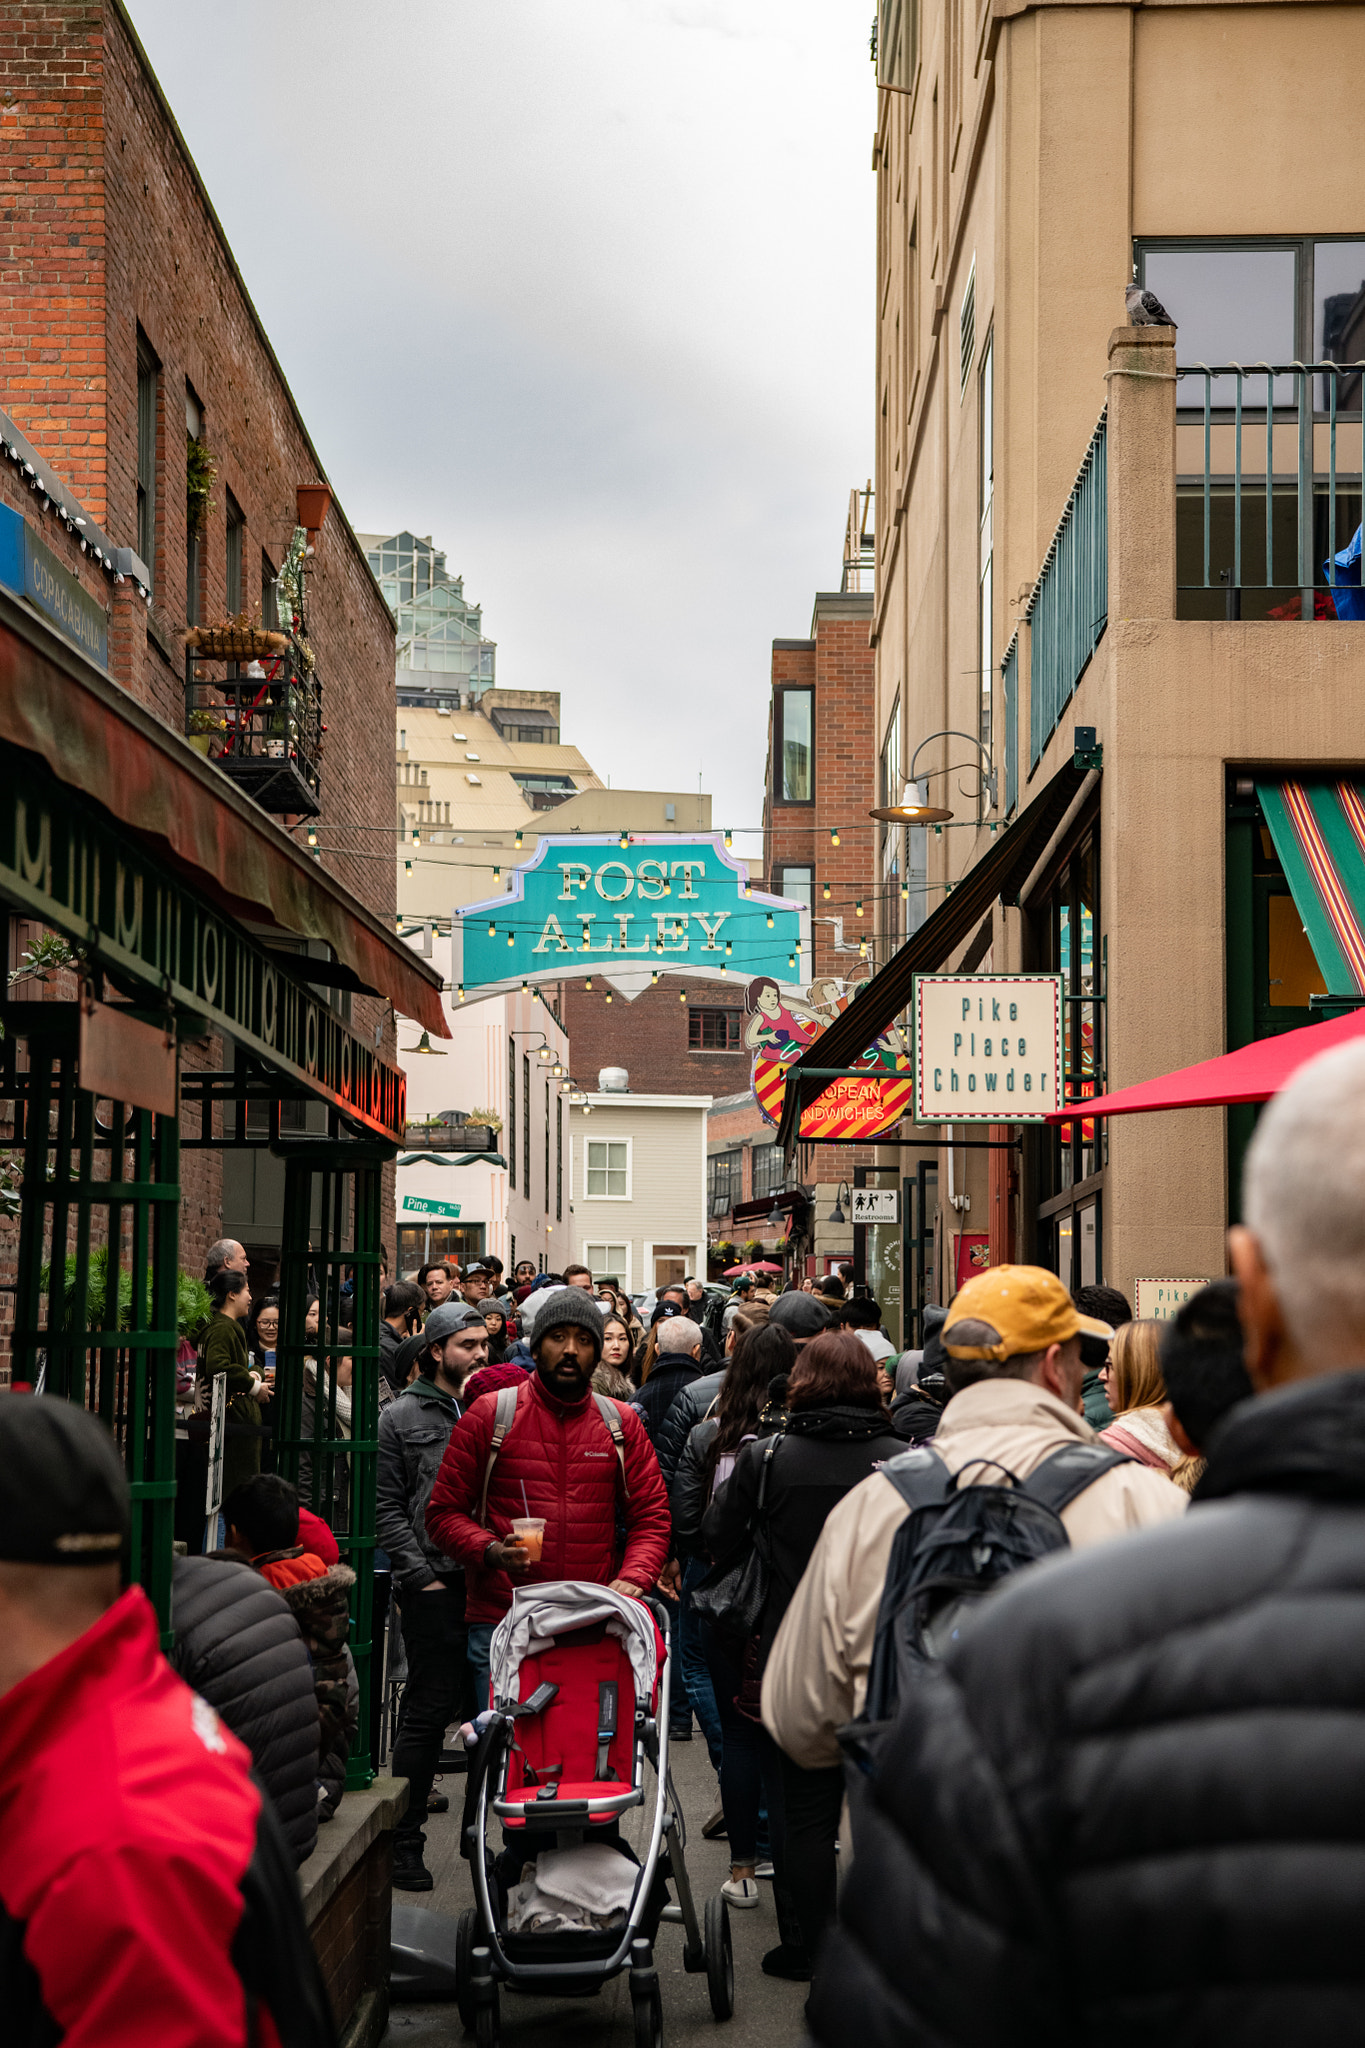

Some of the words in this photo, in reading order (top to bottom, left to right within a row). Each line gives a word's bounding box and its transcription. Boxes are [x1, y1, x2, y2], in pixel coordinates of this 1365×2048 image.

[33, 557, 101, 654] COPACABANA
[557, 859, 706, 902] POST
[531, 911, 732, 953] ALLEY
[961, 997, 1018, 1021] Pike
[953, 1032, 1027, 1057] Place
[933, 1067, 1047, 1092] Chowder
[821, 1084, 881, 1100] OPEAN
[801, 1105, 885, 1121] NDWICHES
[407, 1197, 428, 1211] Pine
[437, 1205, 446, 1215] St
[1158, 1288, 1189, 1302] Pike
[1154, 1306, 1177, 1320] Pla
